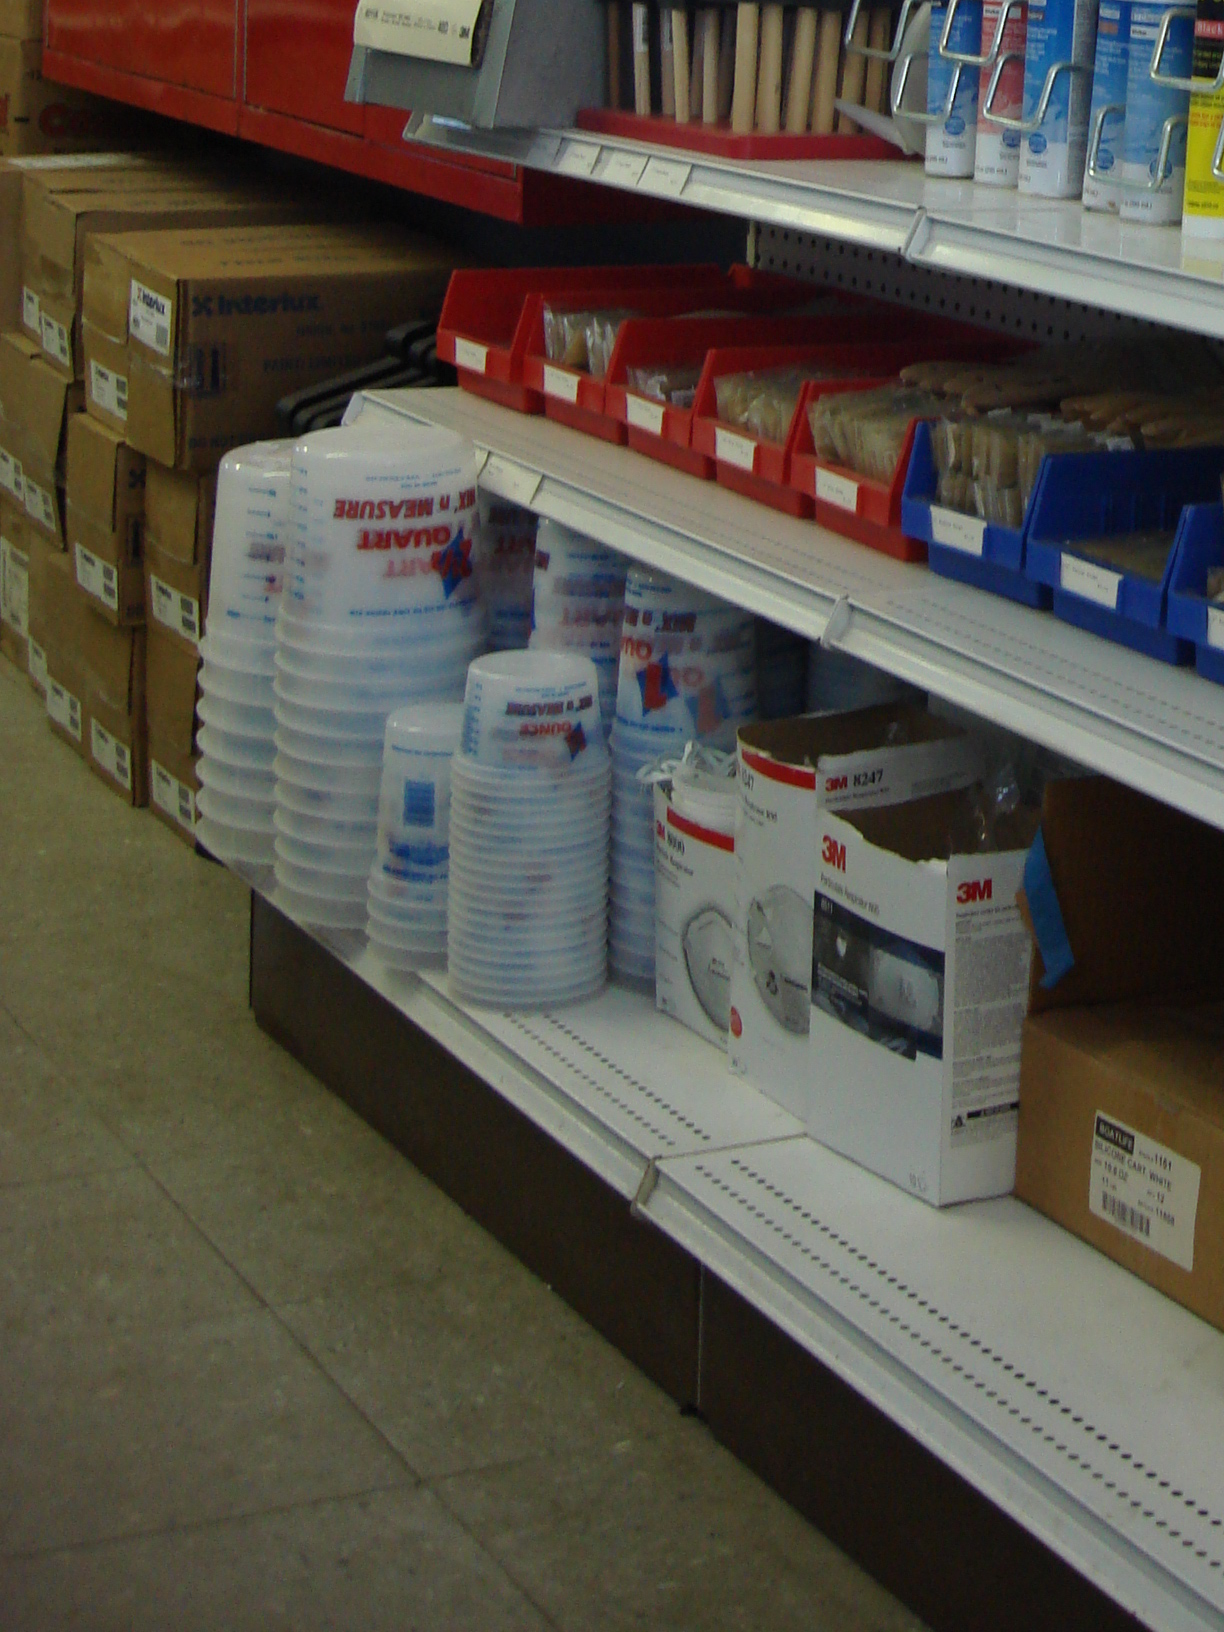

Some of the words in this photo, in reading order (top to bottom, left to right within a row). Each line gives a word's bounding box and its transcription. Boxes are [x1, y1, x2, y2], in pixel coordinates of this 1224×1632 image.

[217, 292, 319, 317] Interlux
[334, 496, 434, 520] MEASURE
[439, 495, 451, 512] n
[356, 526, 452, 552] QUART
[643, 662, 668, 710] 1
[519, 720, 572, 737] OUNCE
[824, 775, 848, 793] 3M
[852, 768, 884, 787] 8247
[821, 834, 847, 875] 3M
[955, 878, 994, 905] 3M
[1098, 1120, 1133, 1153] BOATLIFE
[1149, 1171, 1173, 1193] WHITE
